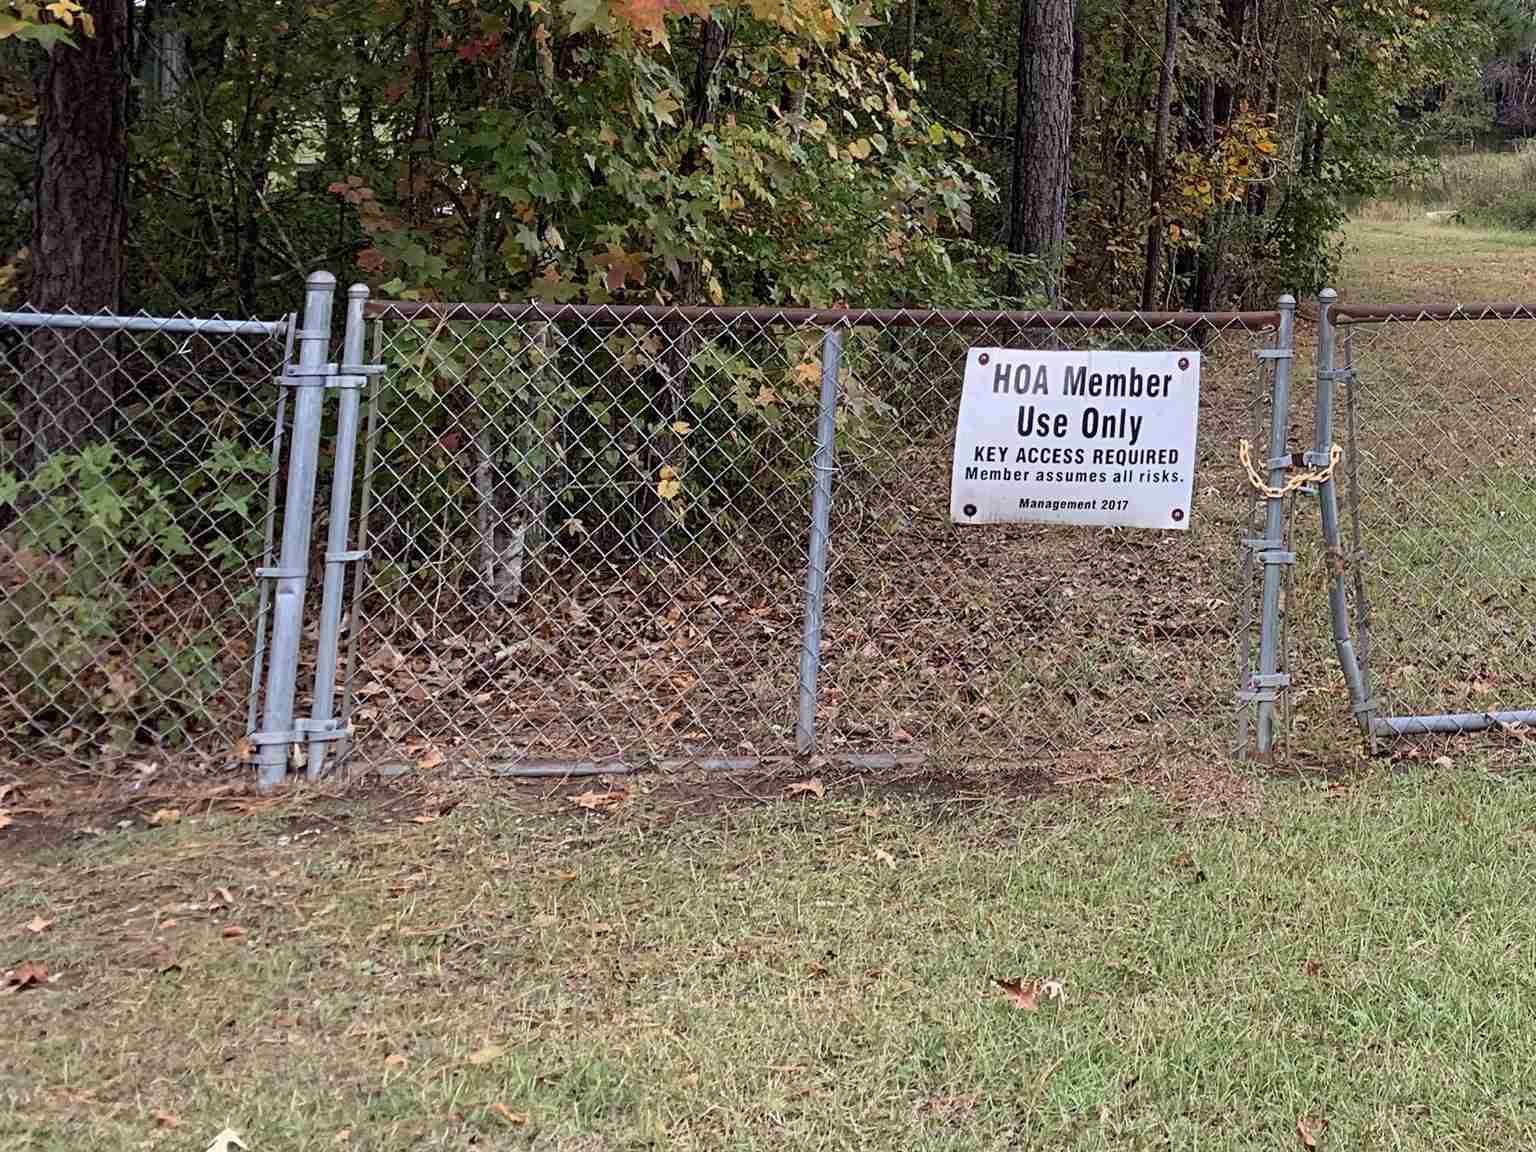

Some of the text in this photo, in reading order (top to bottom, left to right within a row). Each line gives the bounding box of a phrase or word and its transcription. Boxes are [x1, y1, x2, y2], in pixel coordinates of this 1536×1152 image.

[993, 364, 1172, 397] HOA Member
[1017, 406, 1143, 445] Use Only
[974, 446, 1179, 466] KEY ACCESS REQUIRED
[965, 467, 1184, 483] Member assumes all risks.
[1019, 498, 1128, 510] Management 2017
